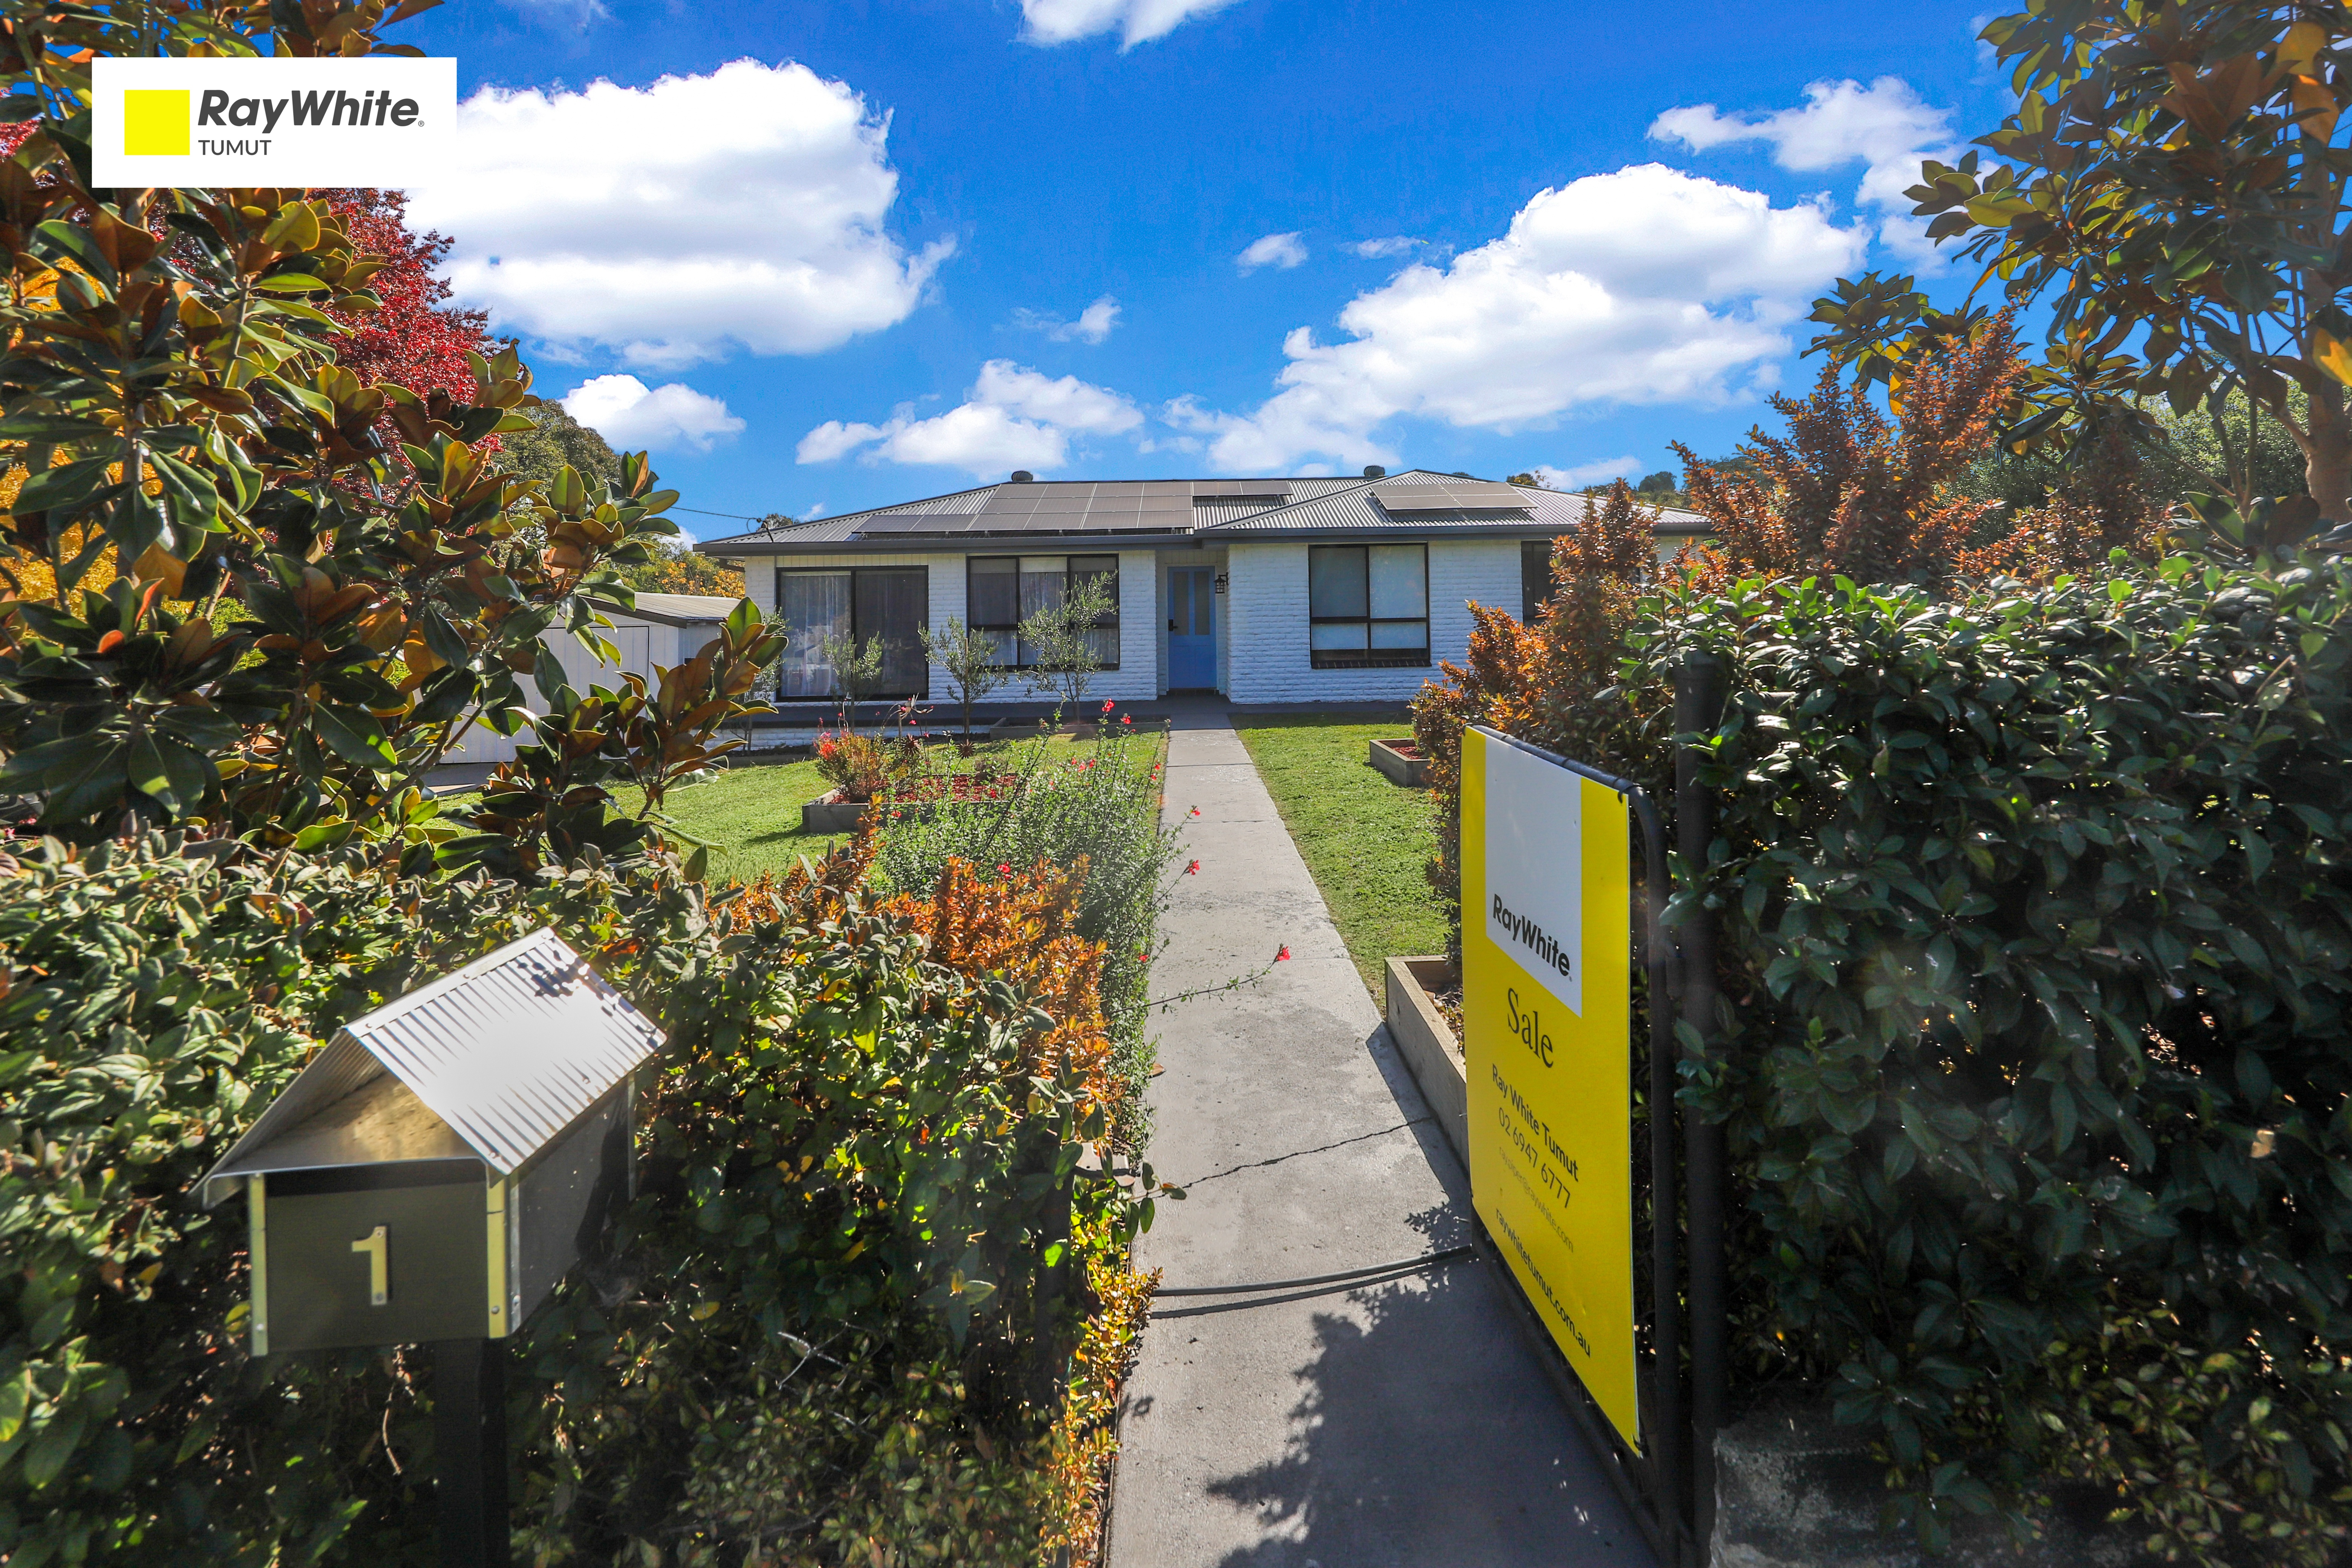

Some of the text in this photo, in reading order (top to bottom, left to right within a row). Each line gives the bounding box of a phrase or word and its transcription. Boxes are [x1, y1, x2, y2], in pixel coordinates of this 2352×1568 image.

[1508, 988, 1554, 1068] Sale
[1492, 1063, 1579, 1182] Ray White Tumut
[1499, 1107, 1571, 1208] 02 6947 6777
[352, 1225, 387, 1305] 1
[1496, 1208, 1591, 1358] raywhitetumut.com.au
